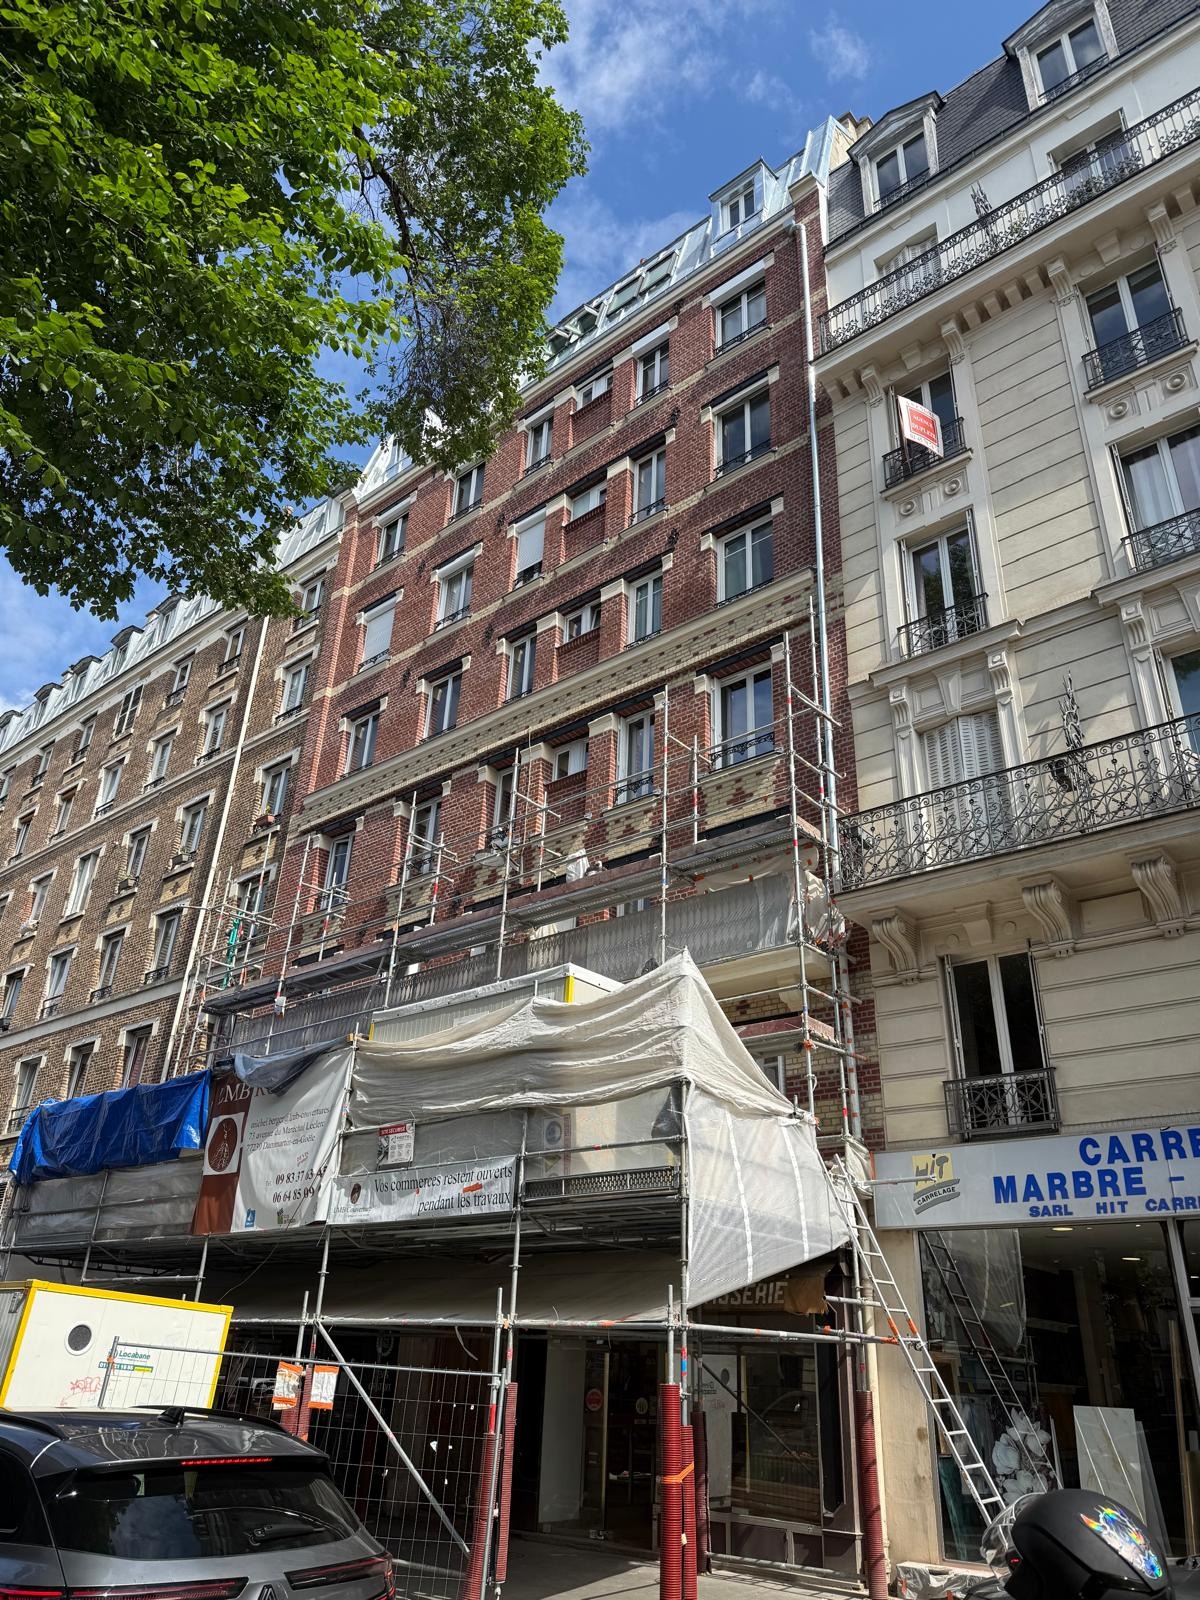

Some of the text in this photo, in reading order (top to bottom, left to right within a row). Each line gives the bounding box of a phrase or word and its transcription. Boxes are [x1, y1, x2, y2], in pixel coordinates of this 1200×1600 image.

[275, 1174, 285, 1185] 09
[285, 1172, 295, 1184] 83
[374, 1165, 513, 1193] Vos commerces restent ouverts
[993, 1166, 1148, 1204] MARBRE
[272, 1191, 282, 1203] 06
[282, 1190, 292, 1202] 64
[292, 1188, 302, 1200] 85
[418, 1191, 511, 1216] pendant les travaux
[917, 1186, 956, 1206] CARRELAGE
[1029, 1196, 1200, 1218] SARL HIT CARR
